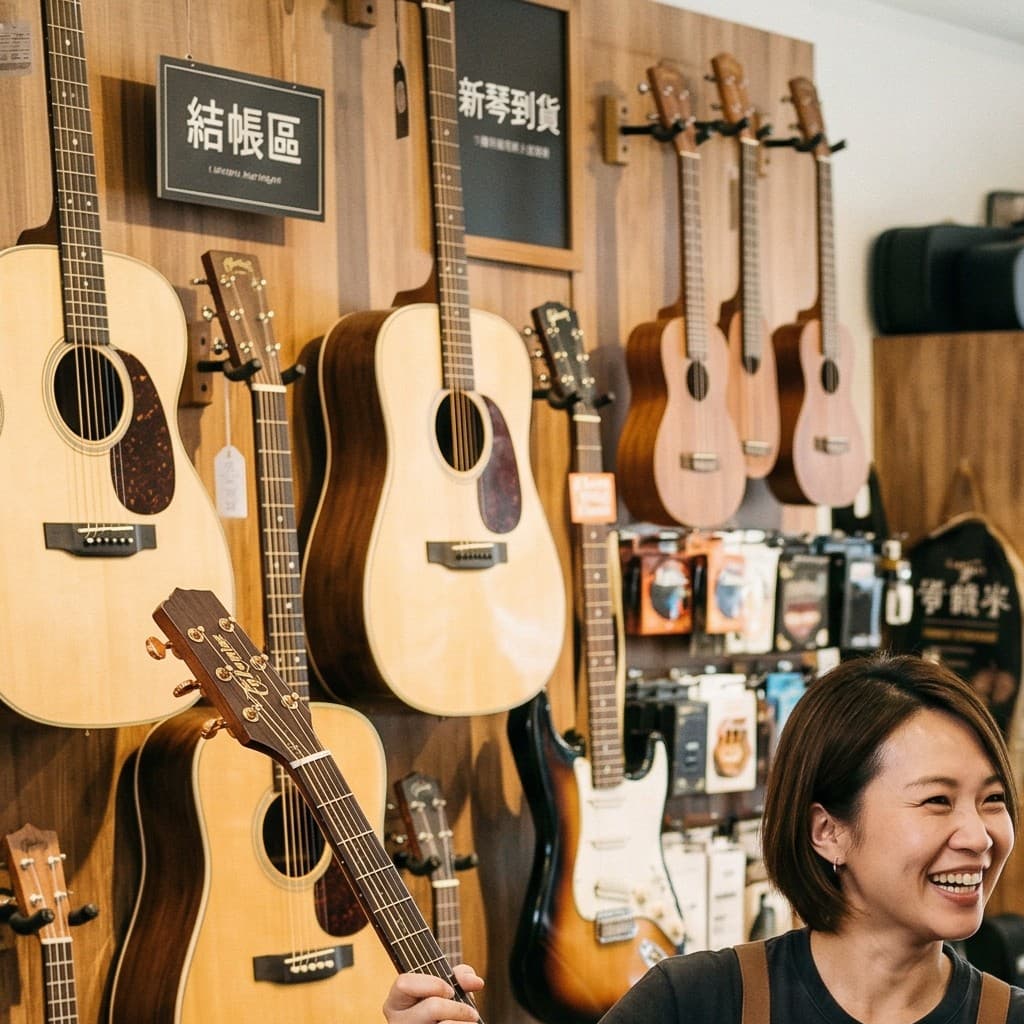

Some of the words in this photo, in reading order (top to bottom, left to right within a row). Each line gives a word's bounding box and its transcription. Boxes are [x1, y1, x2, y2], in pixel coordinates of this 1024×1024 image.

[186, 95, 302, 165] 結帳區
[458, 76, 561, 136] 新琴到貨
